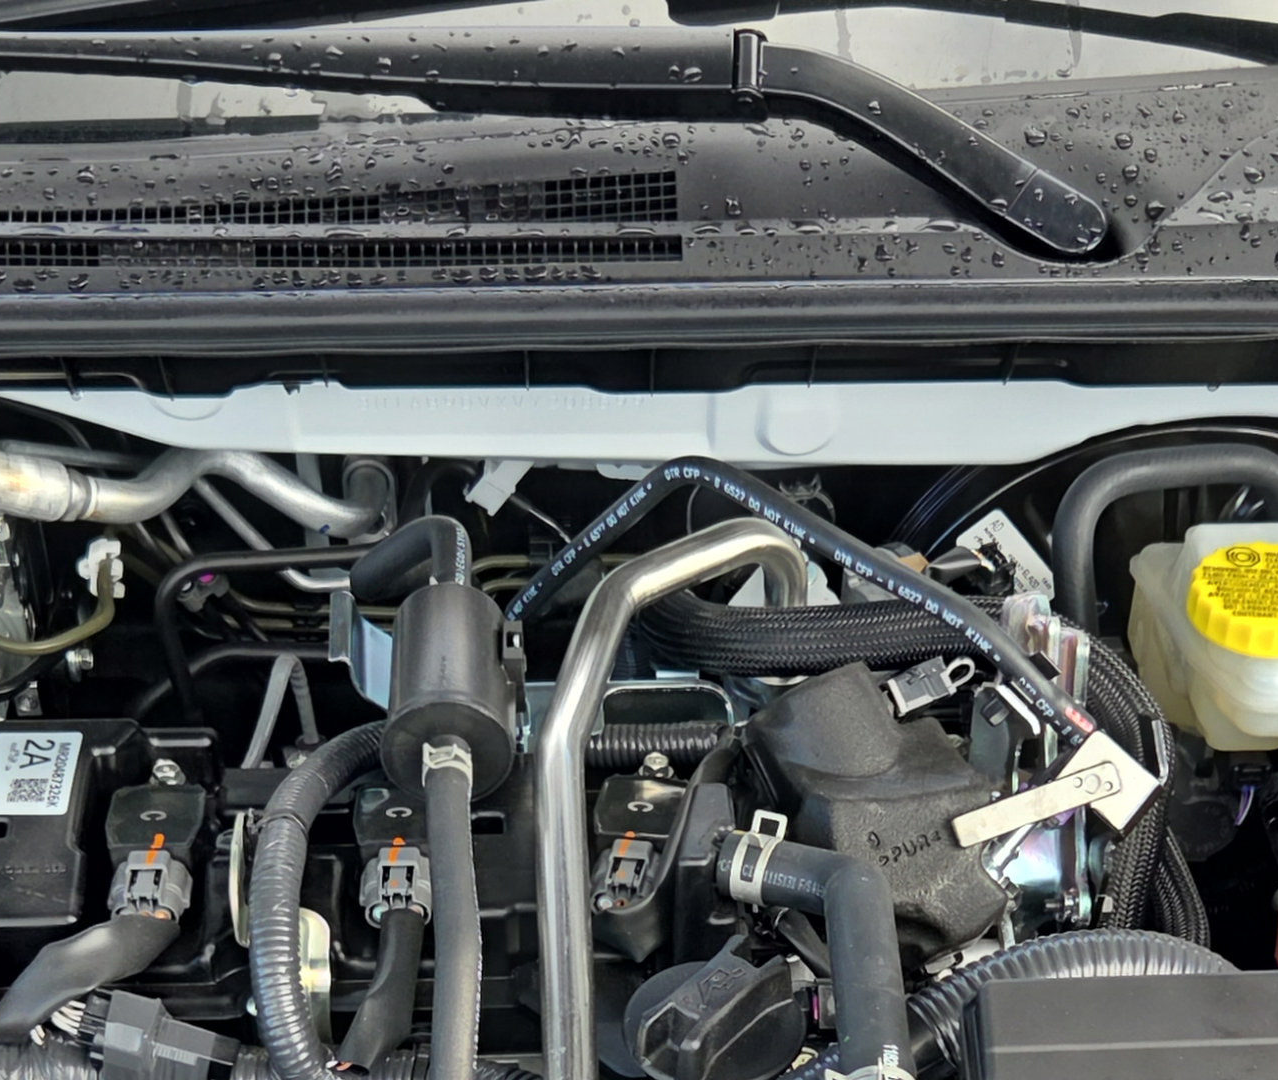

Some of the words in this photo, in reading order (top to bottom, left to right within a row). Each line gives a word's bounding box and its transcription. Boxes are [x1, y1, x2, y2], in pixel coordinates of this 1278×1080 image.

[855, 562, 873, 578] CFP
[897, 584, 922, 606] 6527
[925, 600, 939, 614] DO
[942, 608, 964, 629] NOT
[965, 627, 993, 655] KINK
[19, 739, 56, 769] 2A
